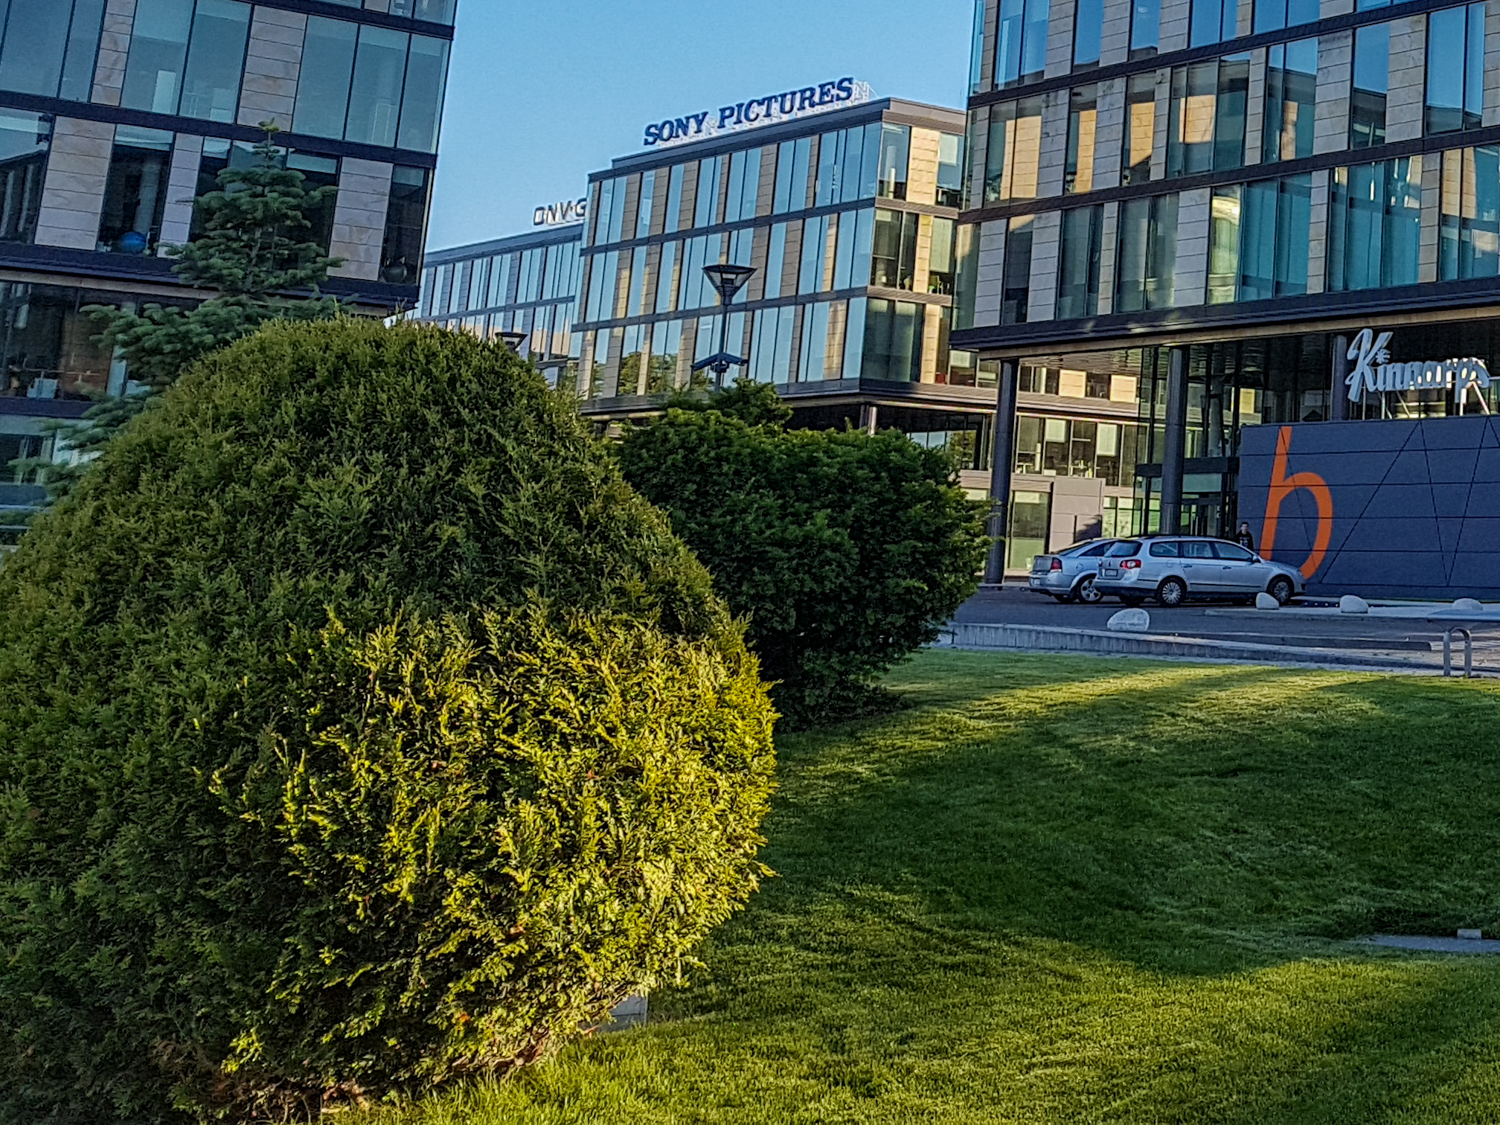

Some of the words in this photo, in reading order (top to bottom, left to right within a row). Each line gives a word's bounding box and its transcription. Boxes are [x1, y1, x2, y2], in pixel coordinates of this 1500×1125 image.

[643, 111, 709, 146] SONY
[717, 77, 854, 129] PICTURES
[1344, 328, 1492, 403] Kinnarps
